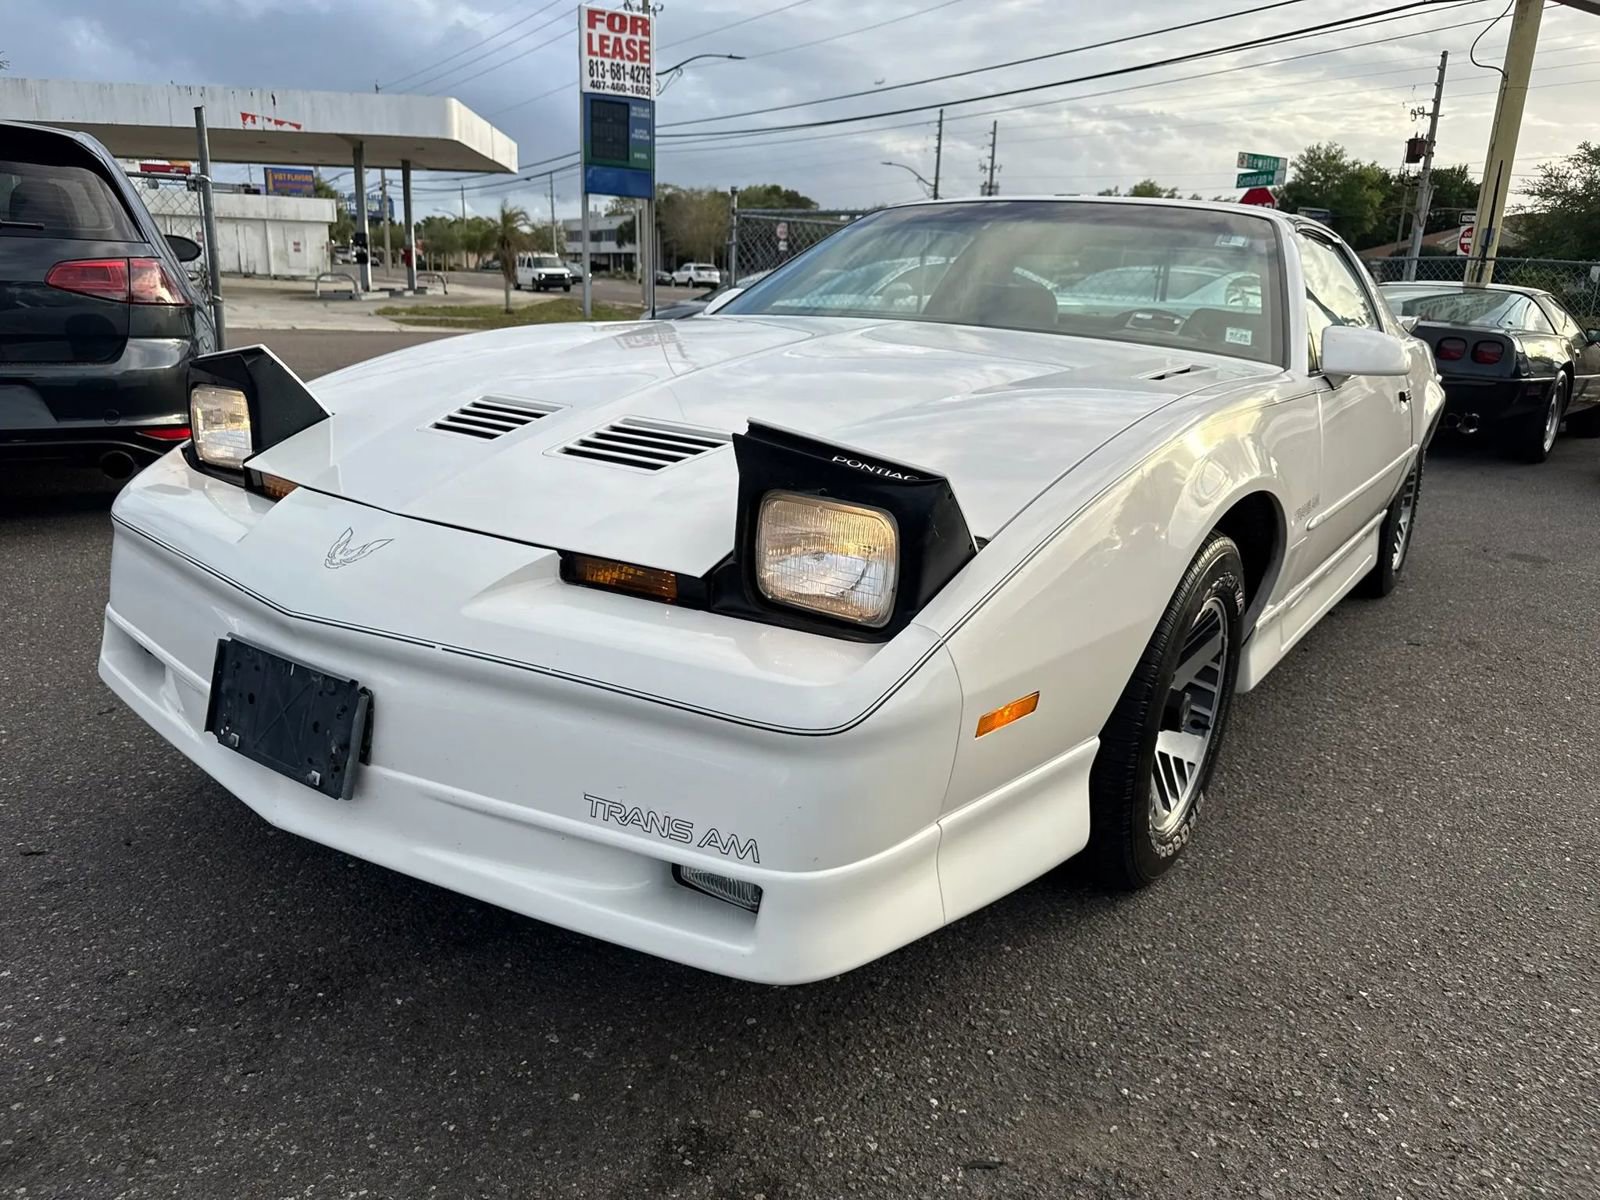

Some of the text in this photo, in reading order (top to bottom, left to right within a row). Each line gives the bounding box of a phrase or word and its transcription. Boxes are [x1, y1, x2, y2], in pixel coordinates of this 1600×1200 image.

[587, 9, 650, 37] FOR
[587, 32, 650, 63] LEASE
[584, 793, 760, 864] TRANS AM
